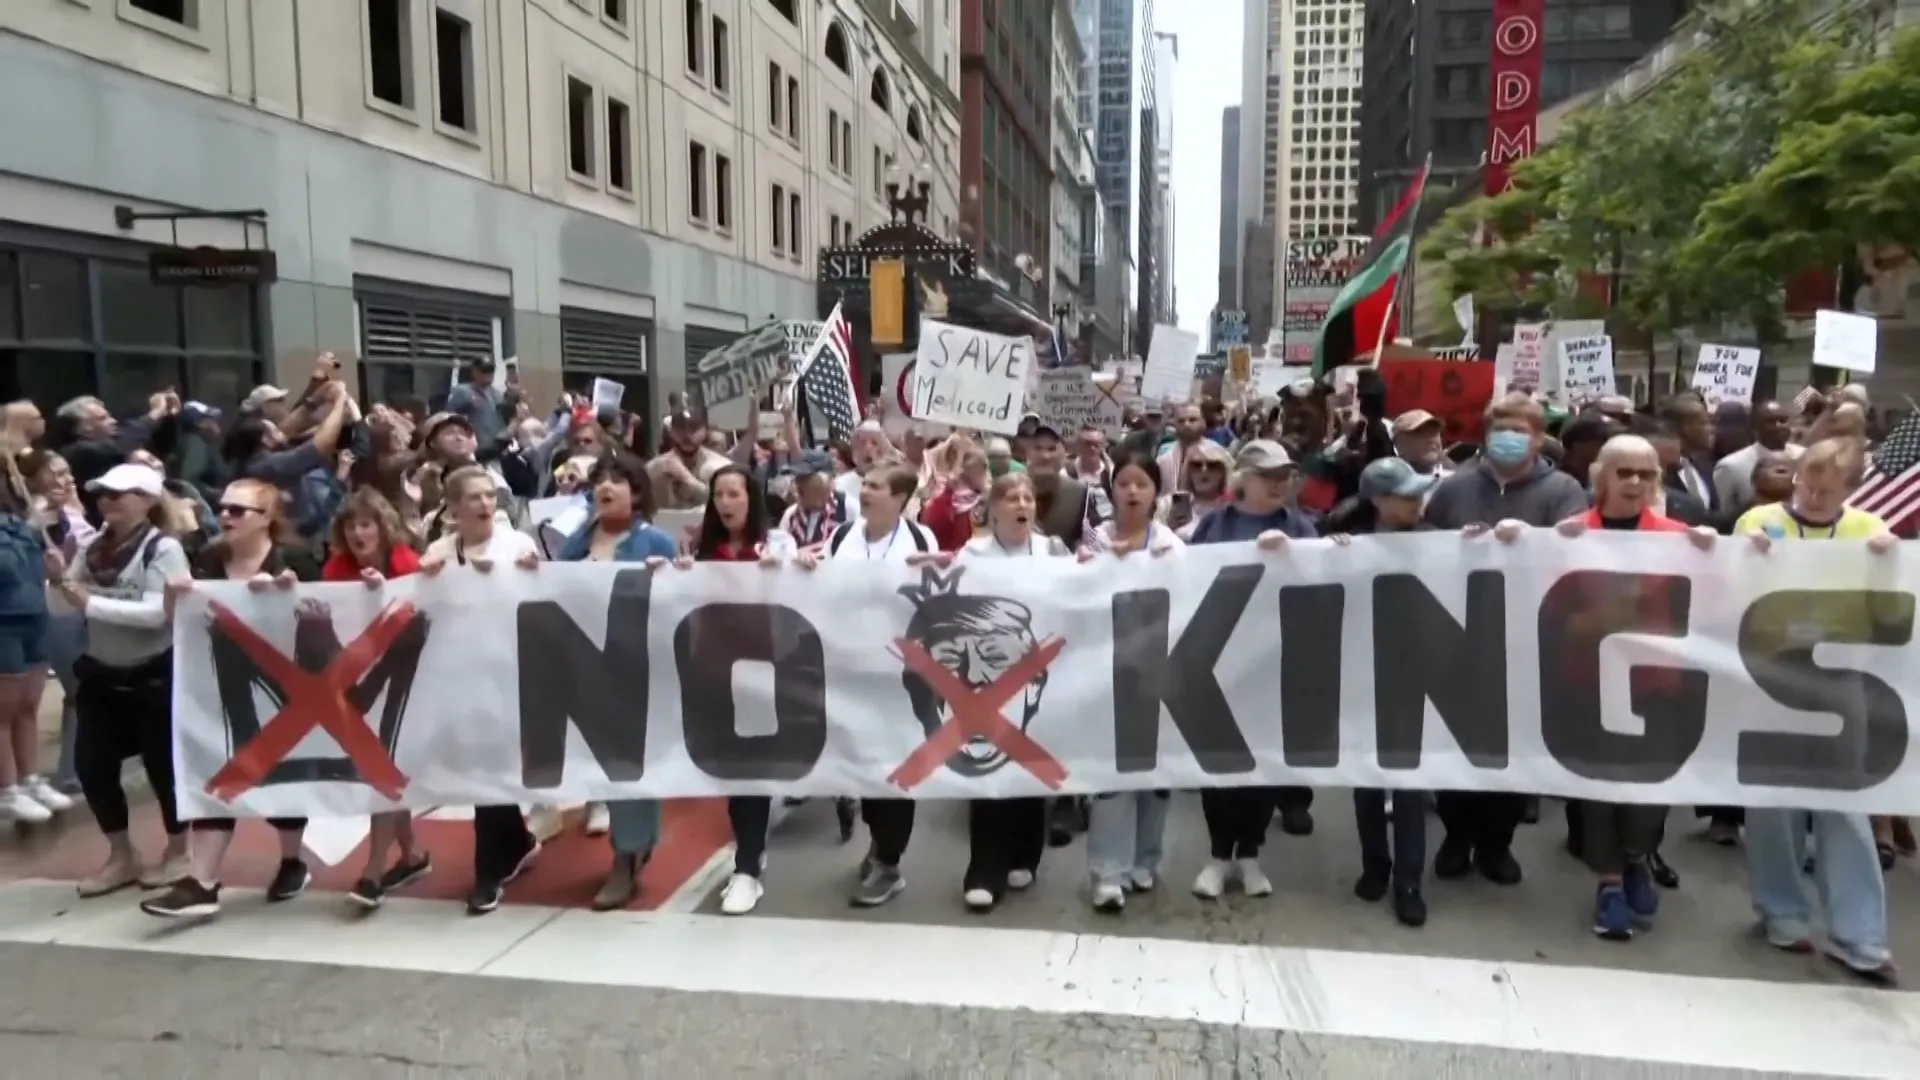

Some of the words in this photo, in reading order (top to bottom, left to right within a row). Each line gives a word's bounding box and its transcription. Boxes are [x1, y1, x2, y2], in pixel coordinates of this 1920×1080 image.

[1491, 15, 1537, 192] ODM
[829, 253, 878, 279] SEL
[1290, 240, 1338, 259] STOP
[1344, 239, 1368, 256] TH
[783, 323, 822, 338] KING
[930, 328, 1024, 379] SAVE
[1714, 347, 1739, 360] YOU
[915, 375, 1012, 420] Medicaid
[517, 568, 827, 788] NO
[1112, 563, 1916, 791] KINGS
